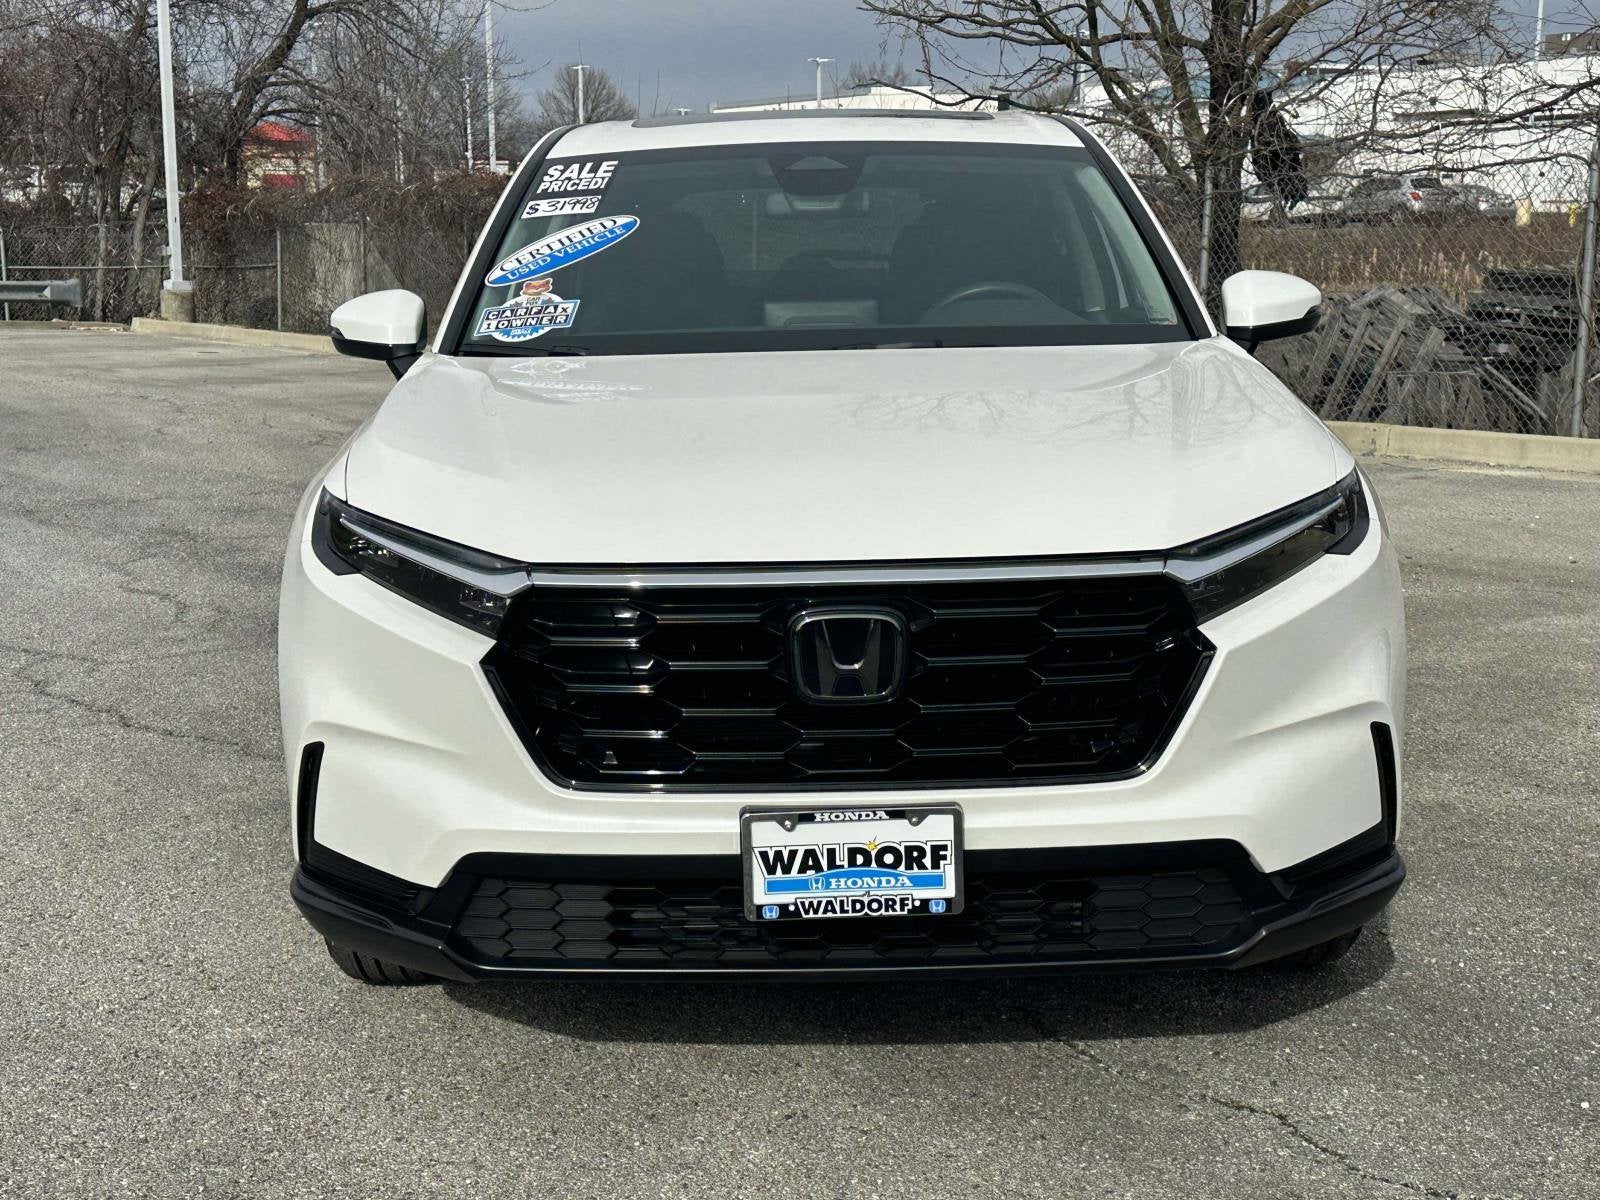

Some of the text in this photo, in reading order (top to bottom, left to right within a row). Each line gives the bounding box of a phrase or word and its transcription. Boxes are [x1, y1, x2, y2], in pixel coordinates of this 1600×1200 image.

[543, 160, 619, 182] SALE
[536, 177, 609, 194] PRICED!
[500, 218, 618, 272] CERTIFIED
[506, 226, 626, 280] USED VEHICLE
[487, 304, 571, 320] CARFAX
[483, 315, 566, 331] 1 OWNER
[813, 810, 890, 822] HONDA
[757, 843, 950, 876] WALDORF
[828, 876, 914, 889] HONDA
[798, 896, 911, 916] WALDORF
